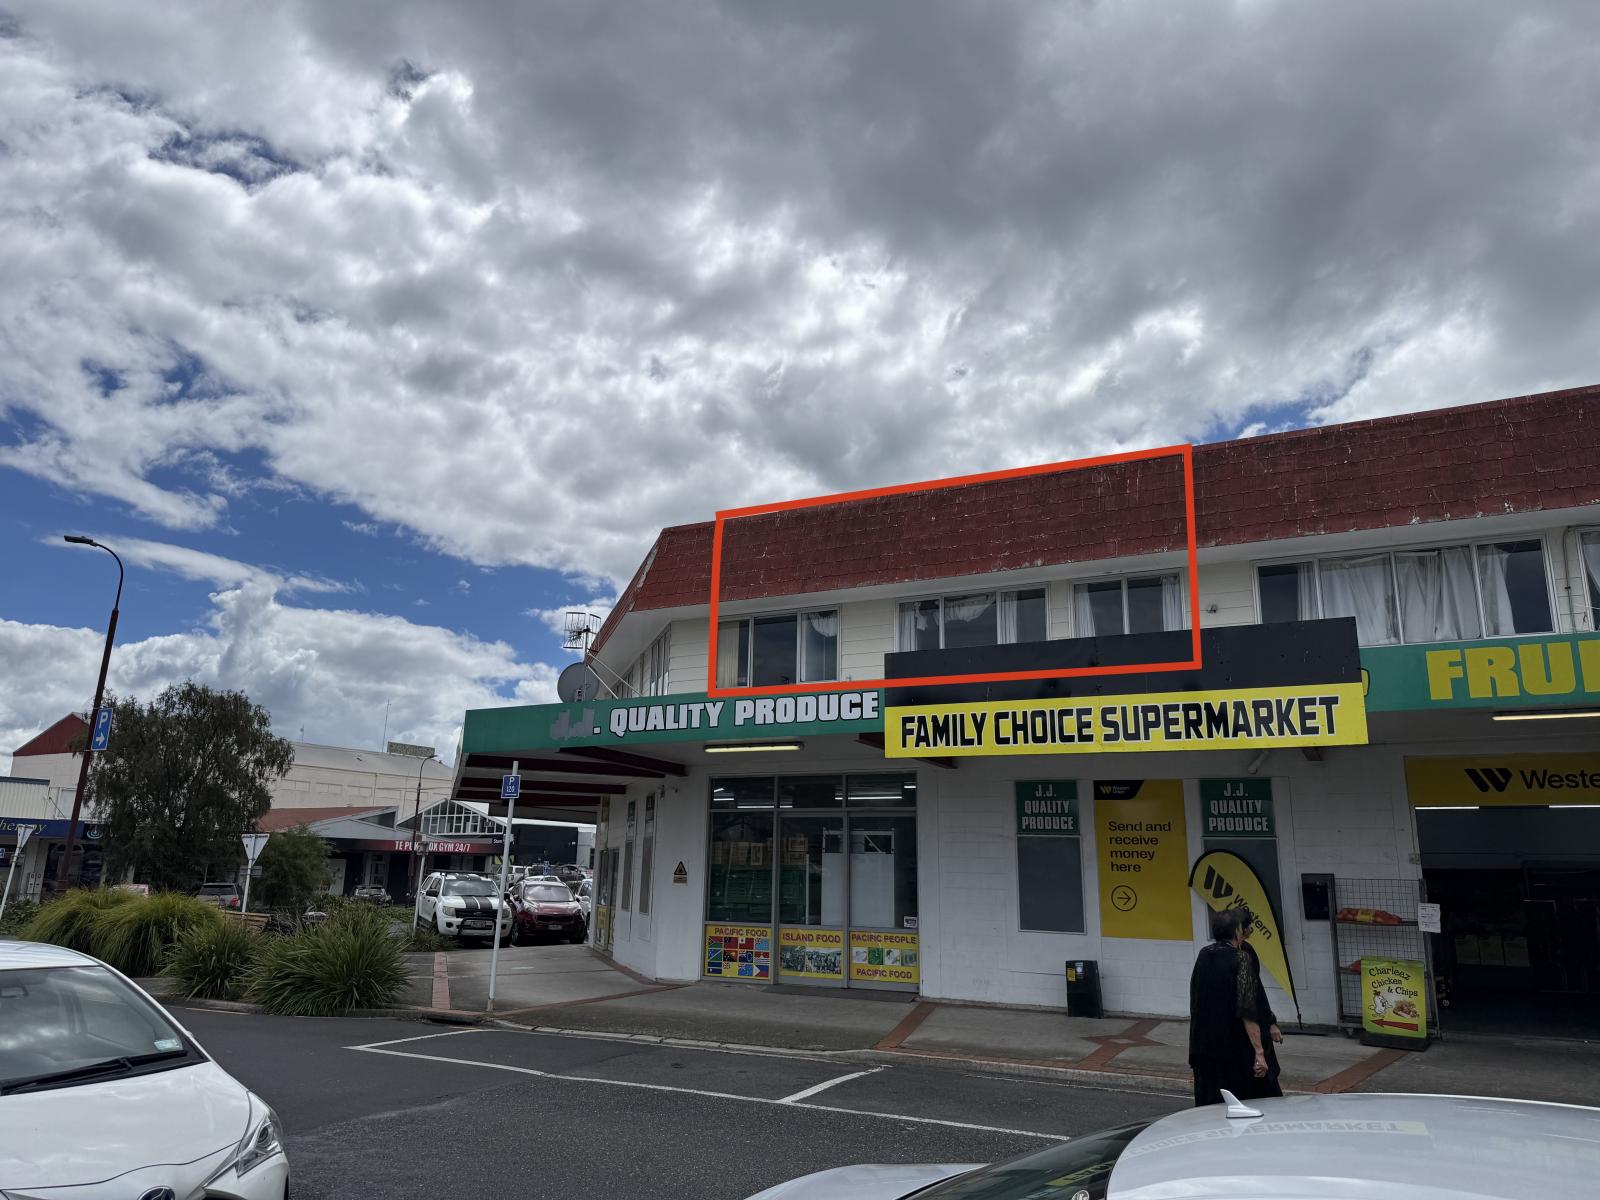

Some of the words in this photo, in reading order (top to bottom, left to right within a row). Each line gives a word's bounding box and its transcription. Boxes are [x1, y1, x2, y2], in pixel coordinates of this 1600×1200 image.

[99, 712, 108, 728] P
[609, 701, 724, 737] QUALITY
[734, 691, 879, 727] PRODUCE
[900, 710, 988, 750] FAMILY
[993, 706, 1095, 747] CHOICE
[1100, 695, 1340, 742] SUPERMARKET
[509, 777, 515, 785] P
[1035, 783, 1057, 798] J.J.
[1223, 782, 1249, 797] J.J.
[1024, 800, 1070, 815] QUALITY
[1210, 799, 1264, 814] QUALITY
[1021, 816, 1074, 830] PRODUCE
[1108, 820, 1143, 832] Send
[1145, 820, 1172, 832] and
[1208, 816, 1269, 832] PRODUCE
[1109, 834, 1159, 846] receive
[395, 841, 403, 850] TE
[439, 843, 454, 852] GYM
[455, 843, 471, 852] 24/7
[1109, 849, 1155, 861] money
[1110, 861, 1142, 873] here
[714, 927, 744, 936] PACIFIC
[745, 928, 768, 937] FOOD
[782, 933, 815, 943] ISLAND
[815, 933, 841, 943] FOOD
[851, 933, 883, 943] PACIFIC
[883, 935, 917, 945] PEOPLE
[856, 968, 888, 978] PACIFIC
[889, 969, 913, 979] FOOD
[1368, 966, 1411, 981] Charleez
[1371, 977, 1403, 989] Chicken
[1395, 986, 1418, 998] Chips
